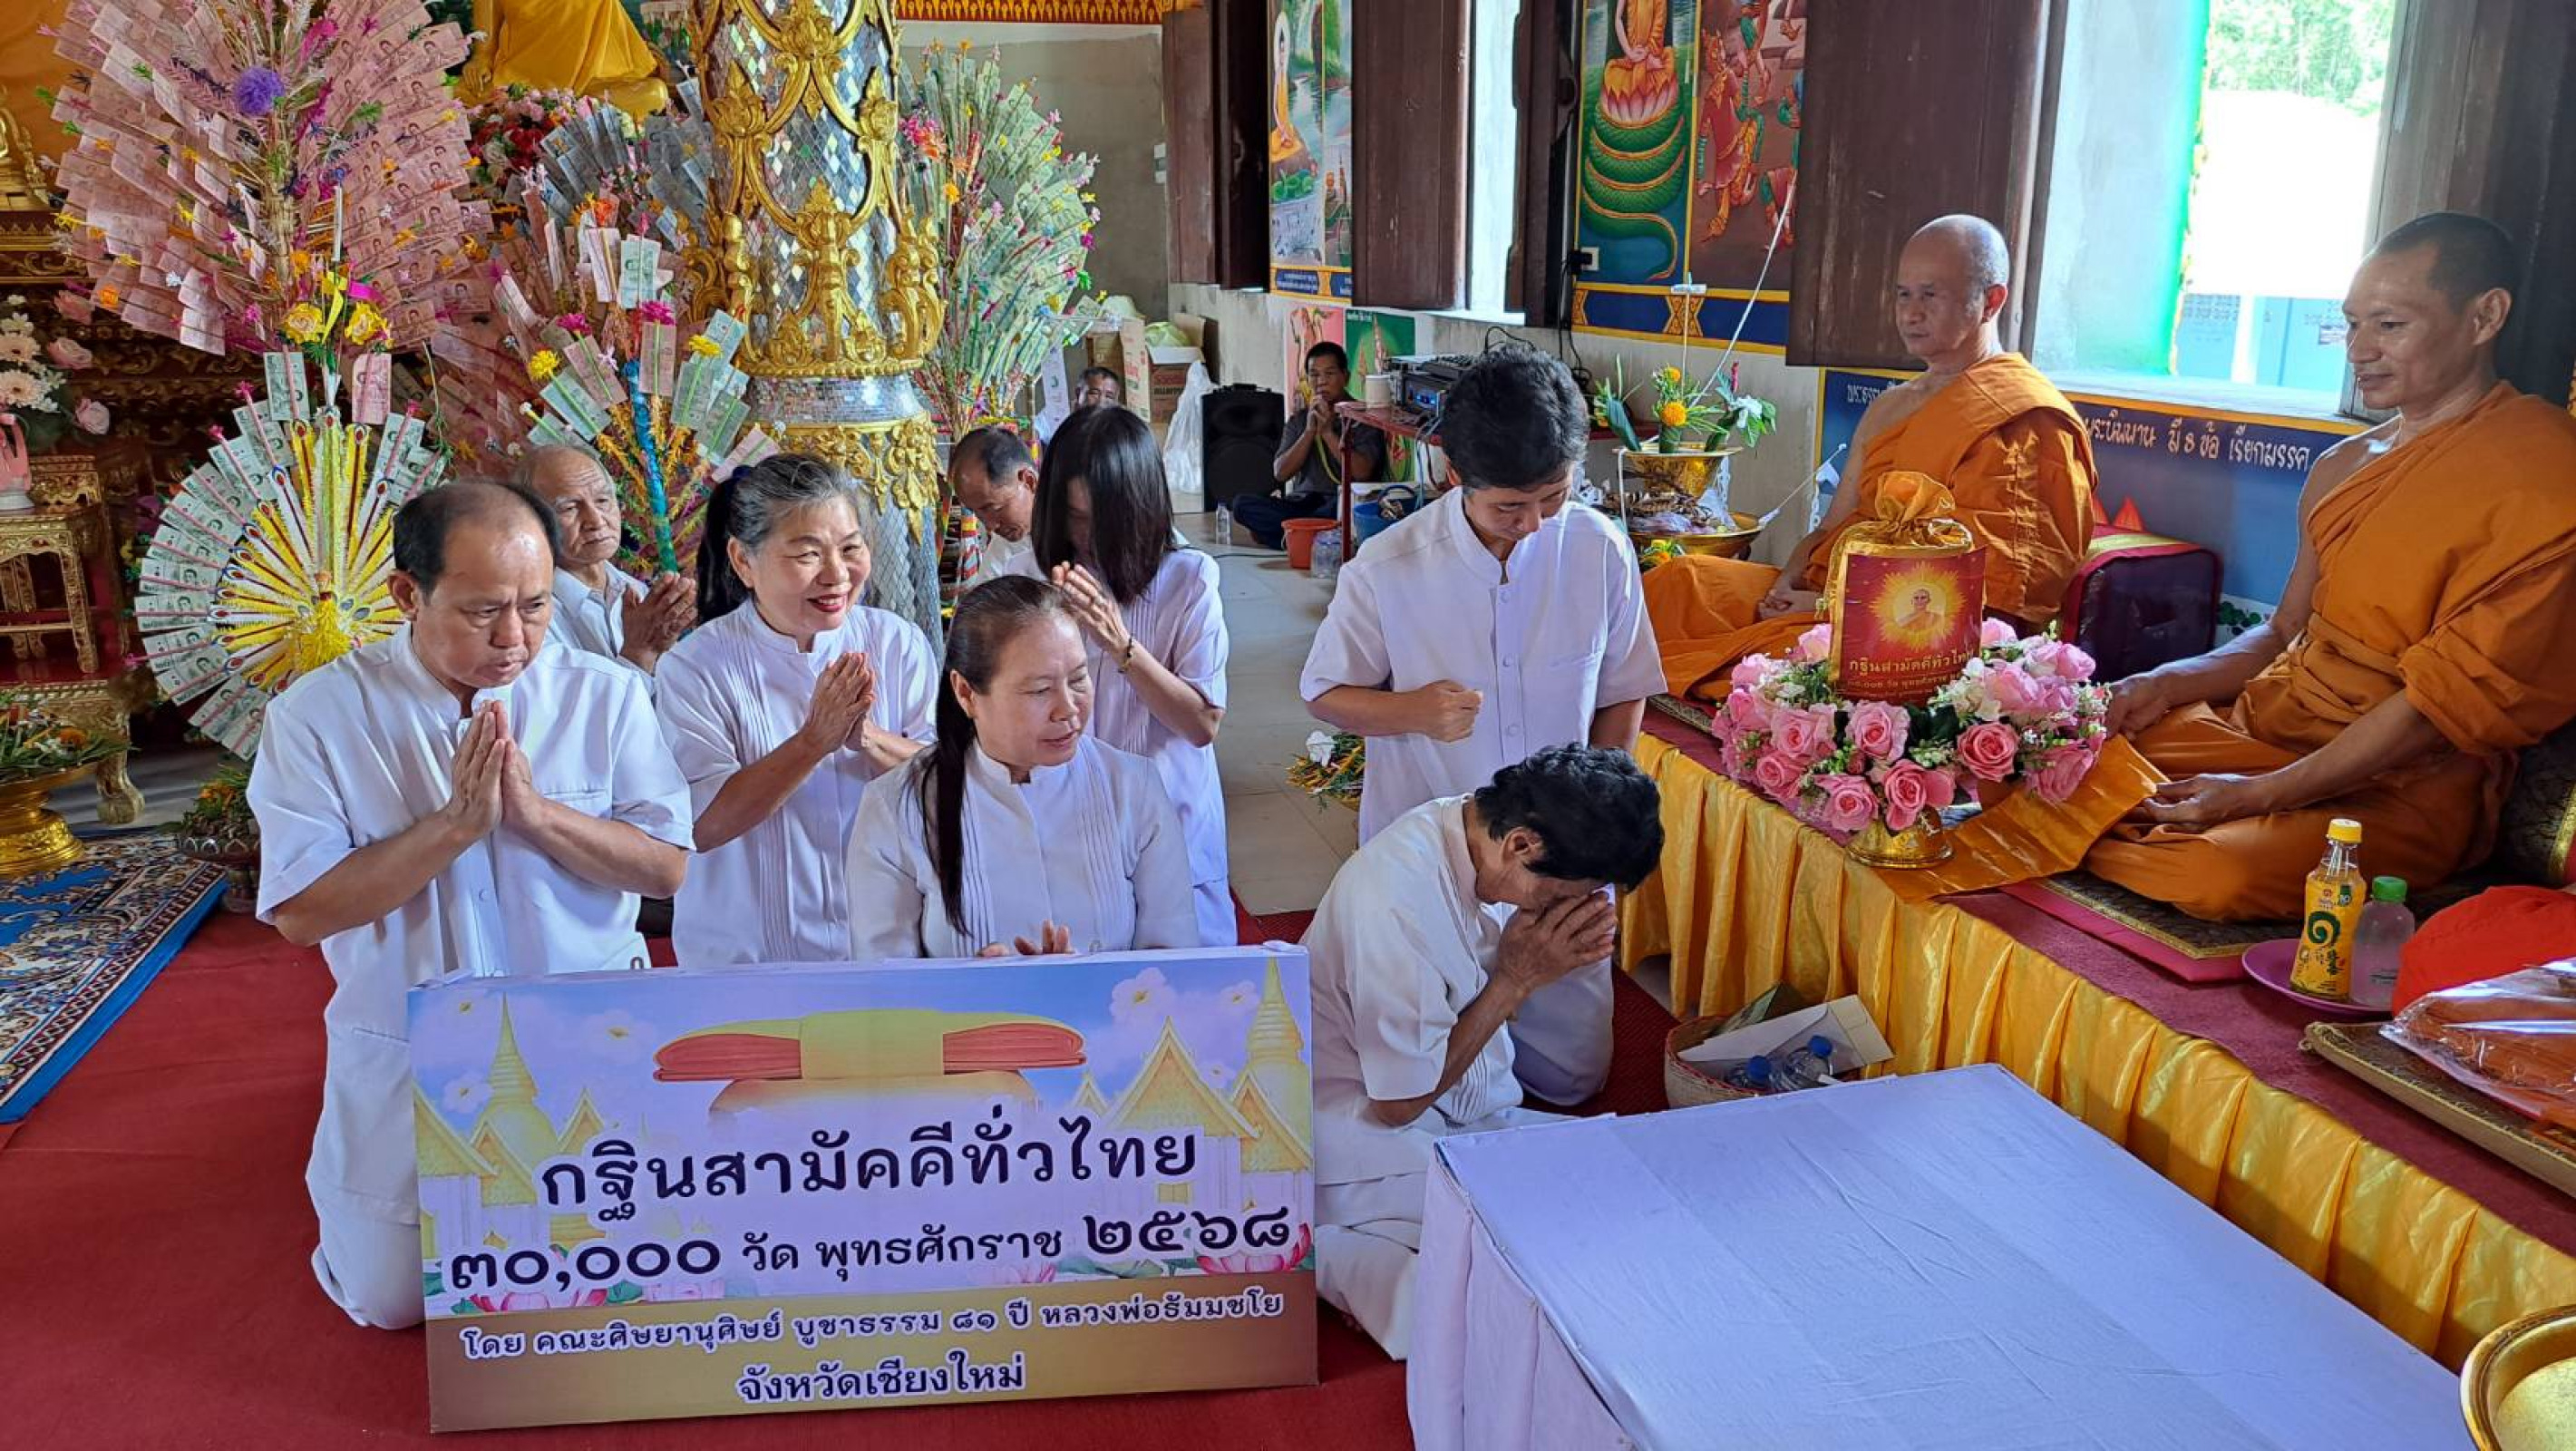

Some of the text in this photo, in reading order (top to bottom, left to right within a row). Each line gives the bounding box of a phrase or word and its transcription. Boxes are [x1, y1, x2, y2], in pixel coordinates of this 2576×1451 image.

[2168, 417, 2182, 453] มี
[2200, 421, 2220, 460] ข้อ
[542, 1104, 1196, 1222] กฐินสามัคคีทั่วไทย
[451, 1206, 1289, 1291] ๓๐,๐๐๐ วัด พุทธศักราช ๒๕๖๘
[462, 1290, 1282, 1357] โดย คณะศิษยานุศิษย์ บูชาธรรม ๘๑ ปี หลวงพ่อธัมมชโย
[739, 1350, 1025, 1402] จังหวัดเชียงใหม่
